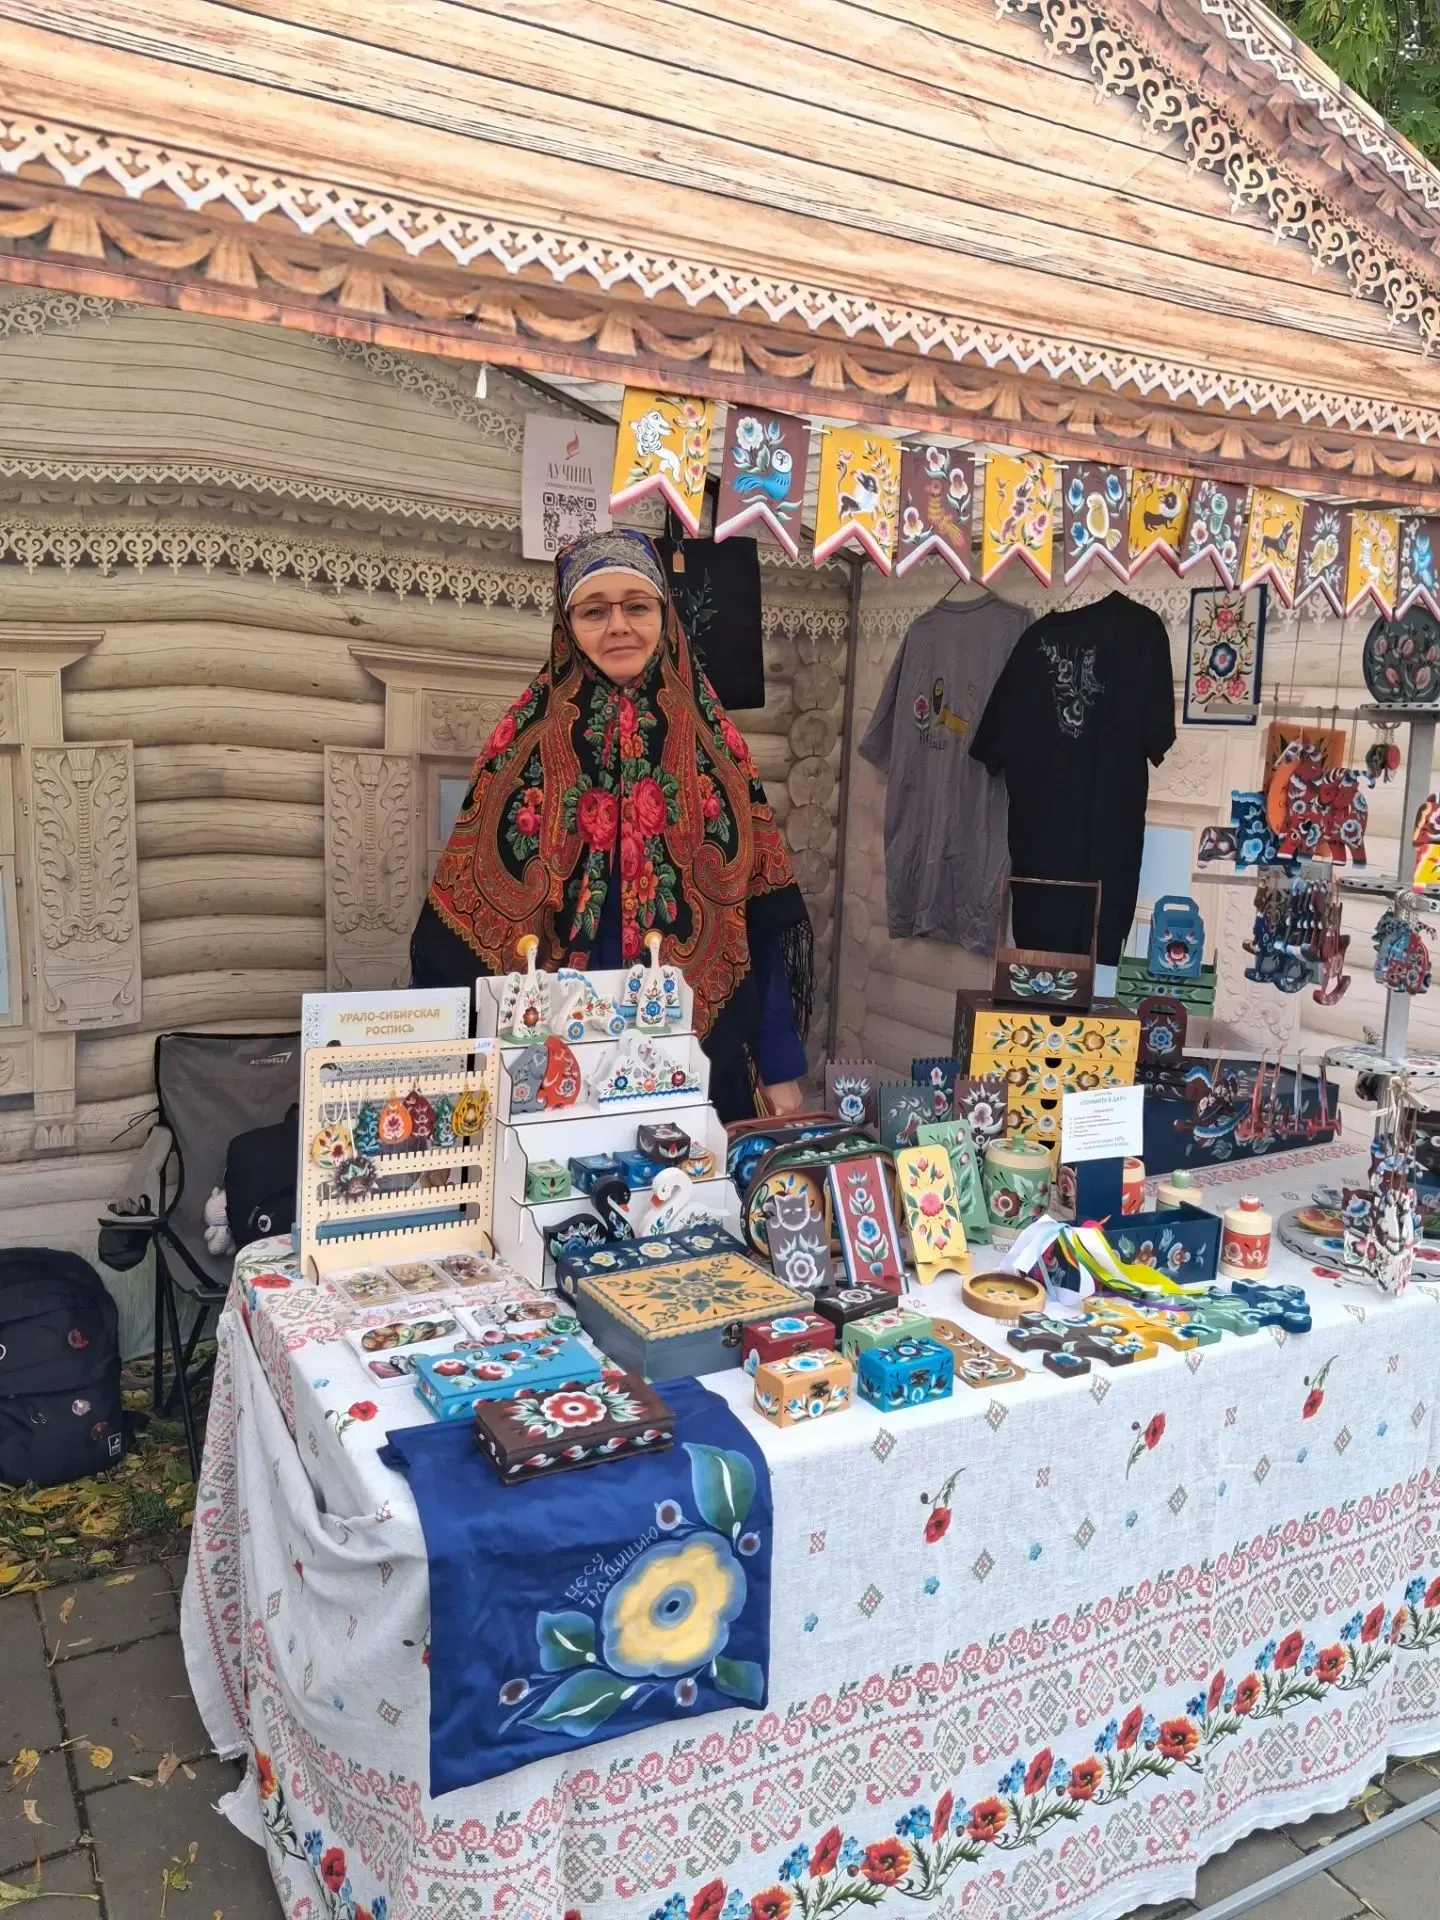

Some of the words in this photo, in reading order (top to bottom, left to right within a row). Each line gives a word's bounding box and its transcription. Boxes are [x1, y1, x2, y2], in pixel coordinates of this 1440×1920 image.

[547, 462, 593, 485] ЛУЧИНА
[339, 1008, 441, 1024] УРАЛО-СИБИРСКАЯ
[365, 1024, 415, 1036] РОСПИСЬ
[249, 1056, 286, 1065] ACTIWELL
[564, 1553, 606, 1602] НЕСУ
